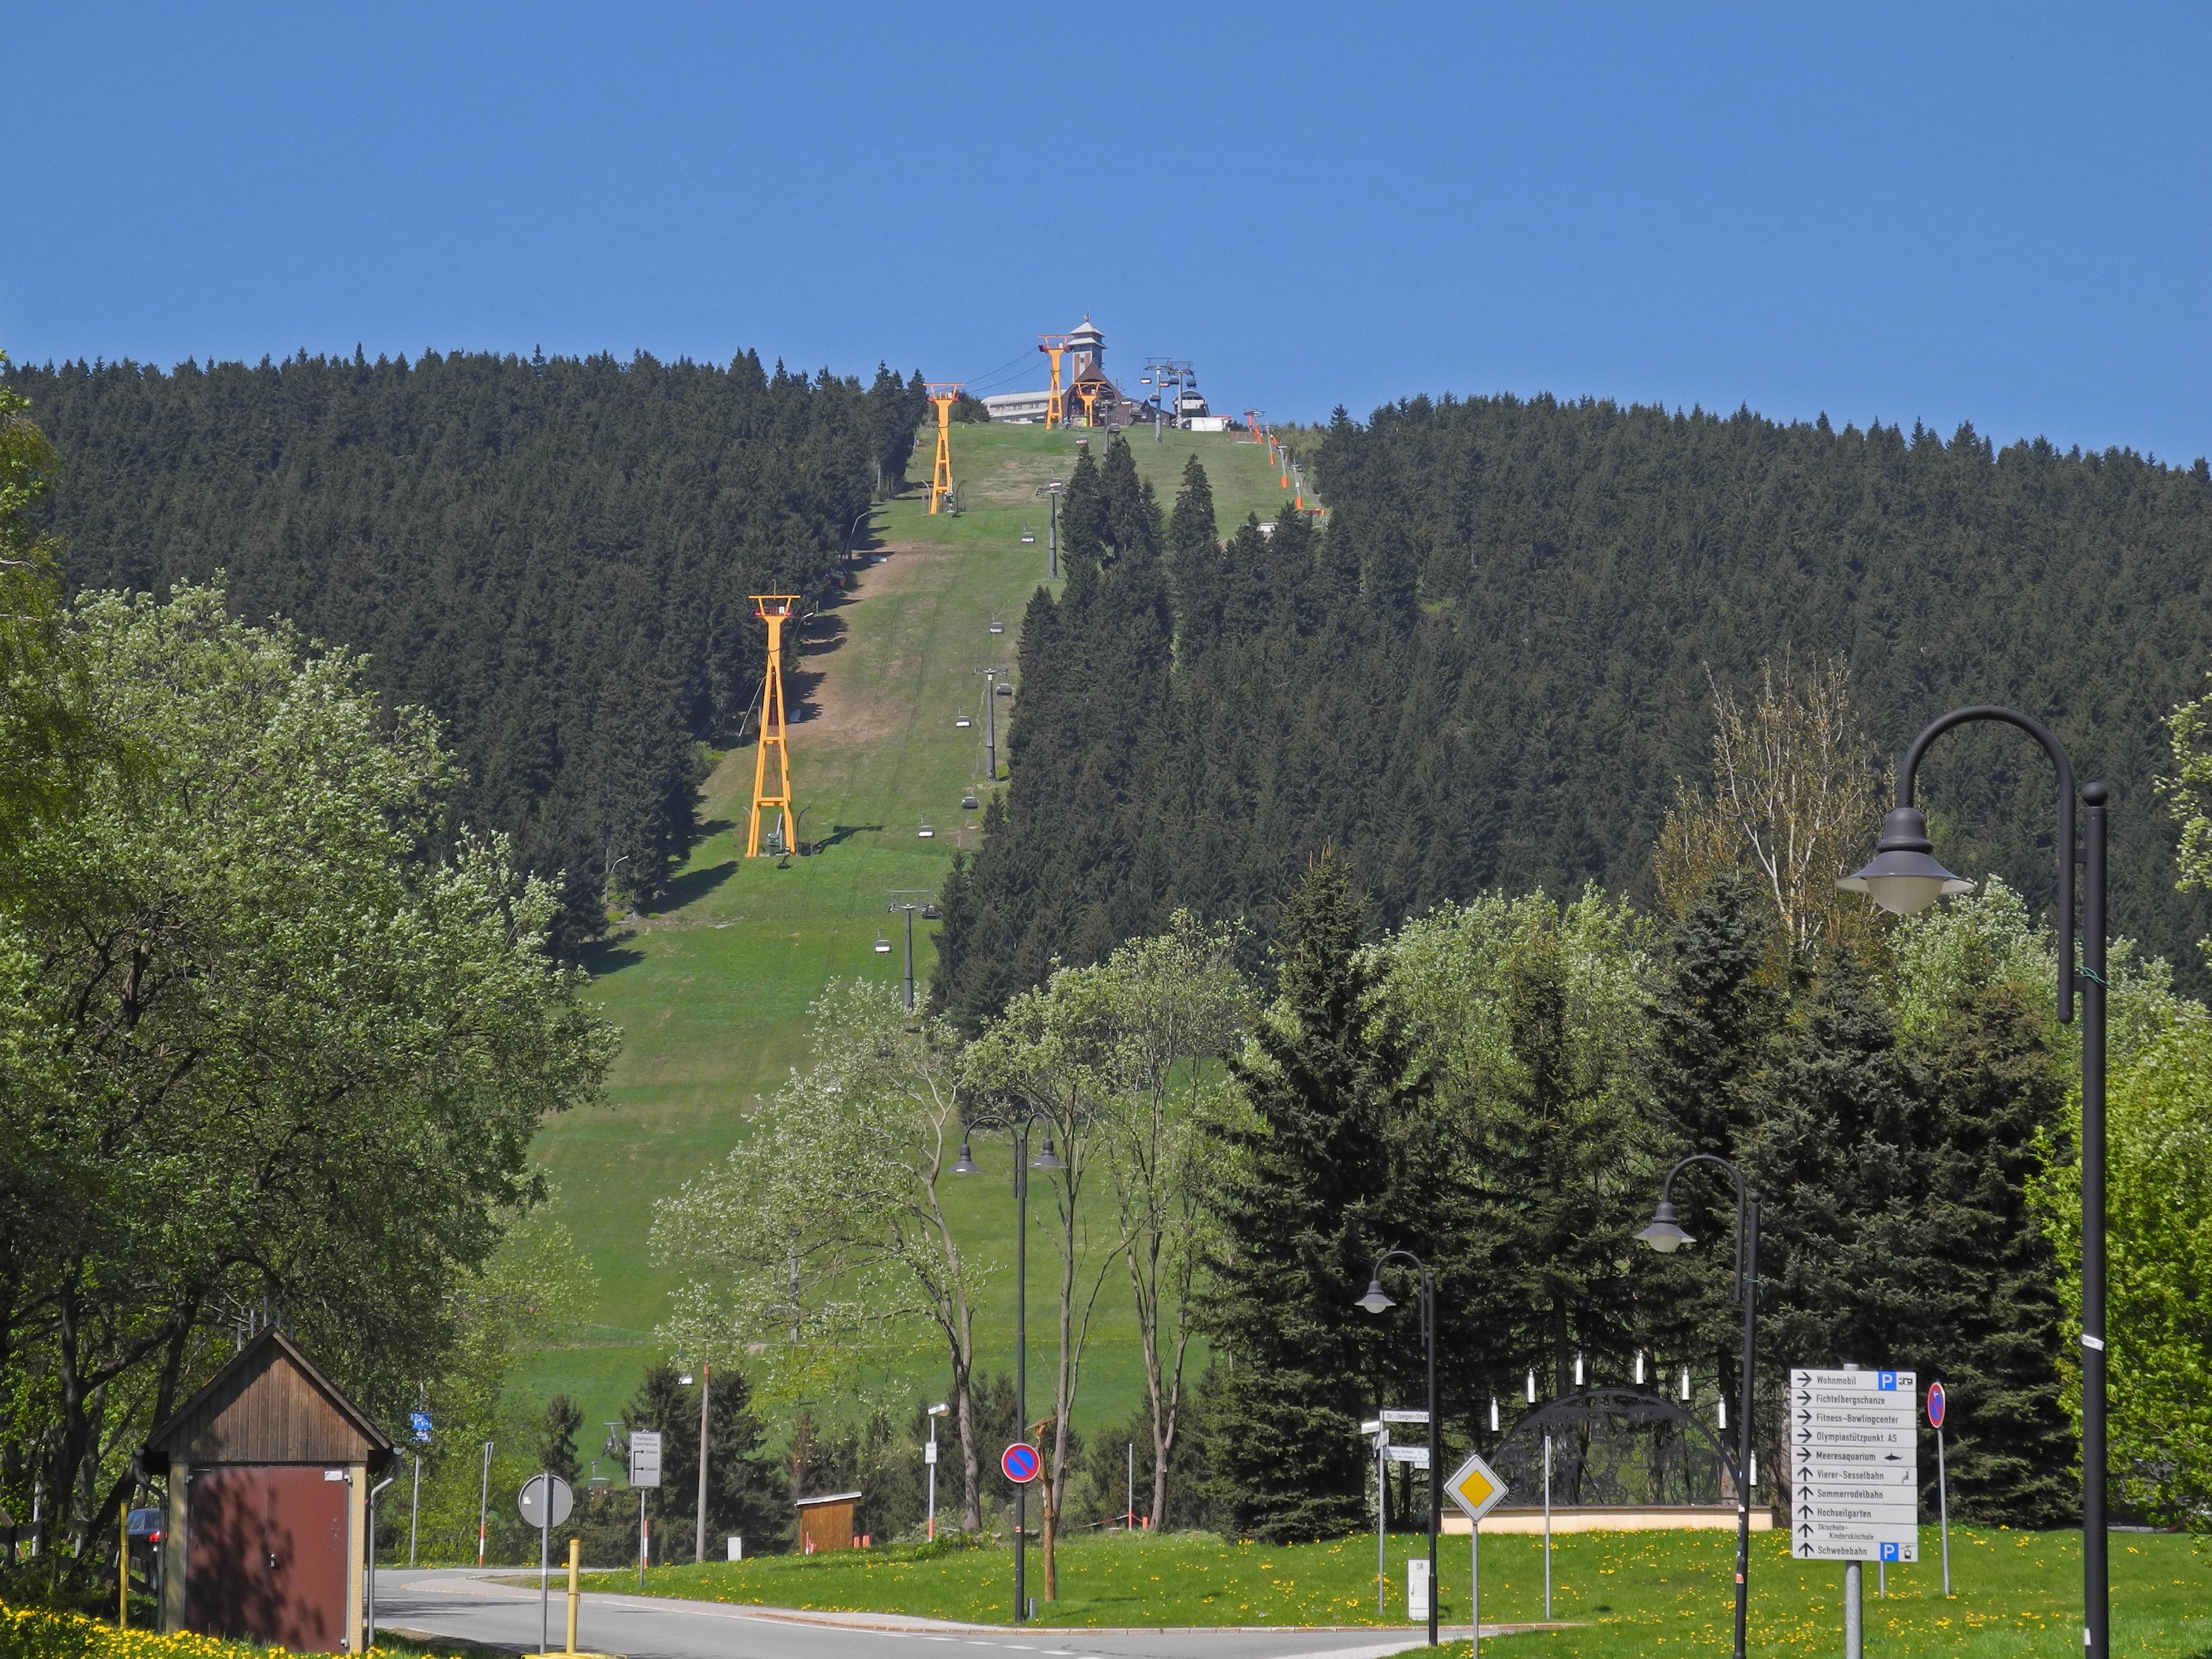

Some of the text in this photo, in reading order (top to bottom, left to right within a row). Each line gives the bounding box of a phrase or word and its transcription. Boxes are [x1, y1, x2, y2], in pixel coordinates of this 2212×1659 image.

[1817, 1374, 1893, 1388] Wohnmobil P
[1817, 1394, 1885, 1406] Fichtelbergschanze
[1817, 1413, 1899, 1425] Fitness-Bowlingcenter
[1817, 1432, 1897, 1443] Olympiastützpunkt AS
[1816, 1451, 1876, 1462] Meeresaquarium
[1817, 1470, 1884, 1480] Vierer-Sesselbahn
[1817, 1489, 1883, 1499] Sommerrodelbahn
[1817, 1508, 1871, 1519] Hochseilgarten
[1818, 1544, 1895, 1559] Schwebebahn P
